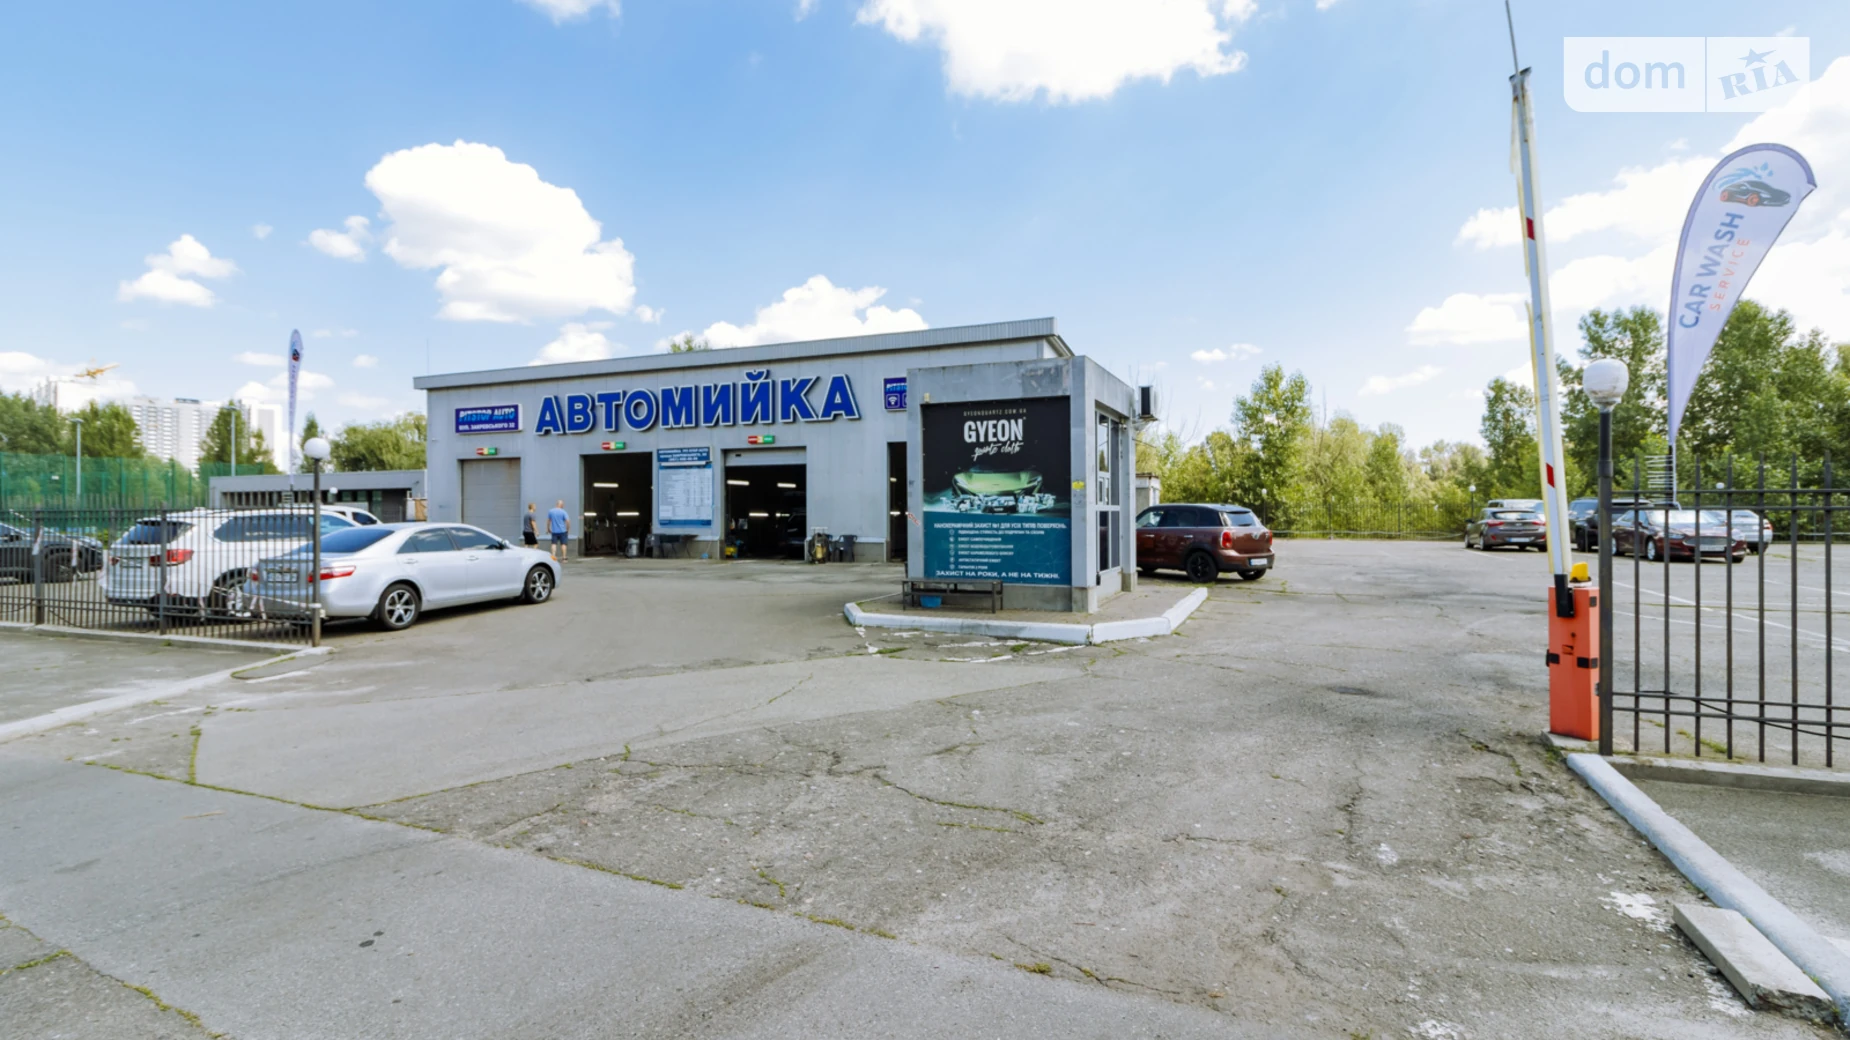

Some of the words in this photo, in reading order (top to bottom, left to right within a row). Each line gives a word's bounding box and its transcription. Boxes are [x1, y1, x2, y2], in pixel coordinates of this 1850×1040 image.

[1695, 212, 1745, 277] WASH
[1709, 239, 1750, 311] SERVICE
[1679, 283, 1712, 328] CAR
[492, 408, 516, 420] AUTO
[534, 370, 861, 435] АВТОМИЙКА
[964, 418, 1023, 443] GYEON
